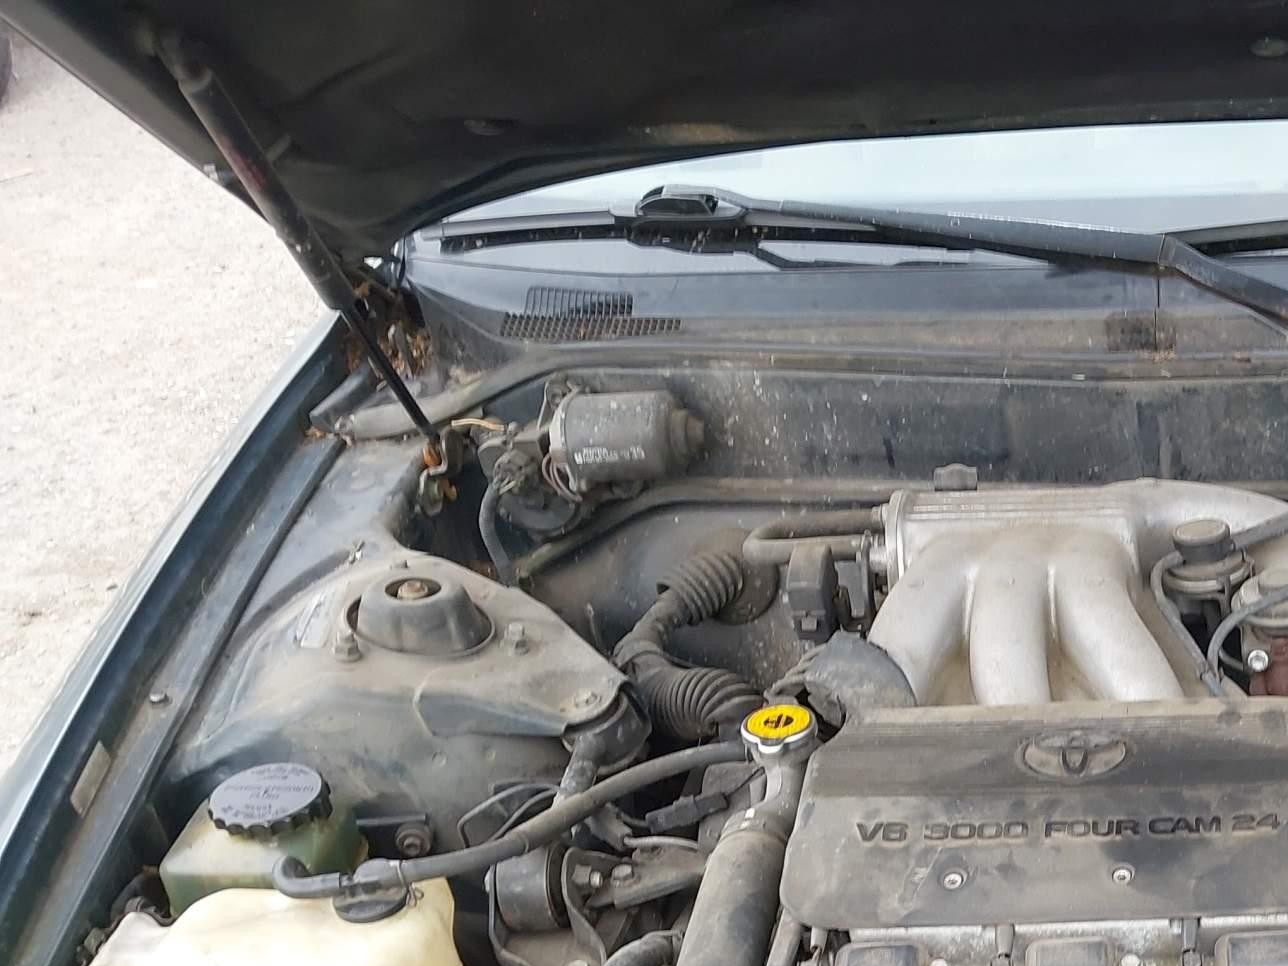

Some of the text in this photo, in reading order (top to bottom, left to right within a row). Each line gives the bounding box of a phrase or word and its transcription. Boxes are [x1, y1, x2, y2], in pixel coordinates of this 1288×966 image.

[856, 813, 1281, 842] V6 3000 FOUR CAM 24
